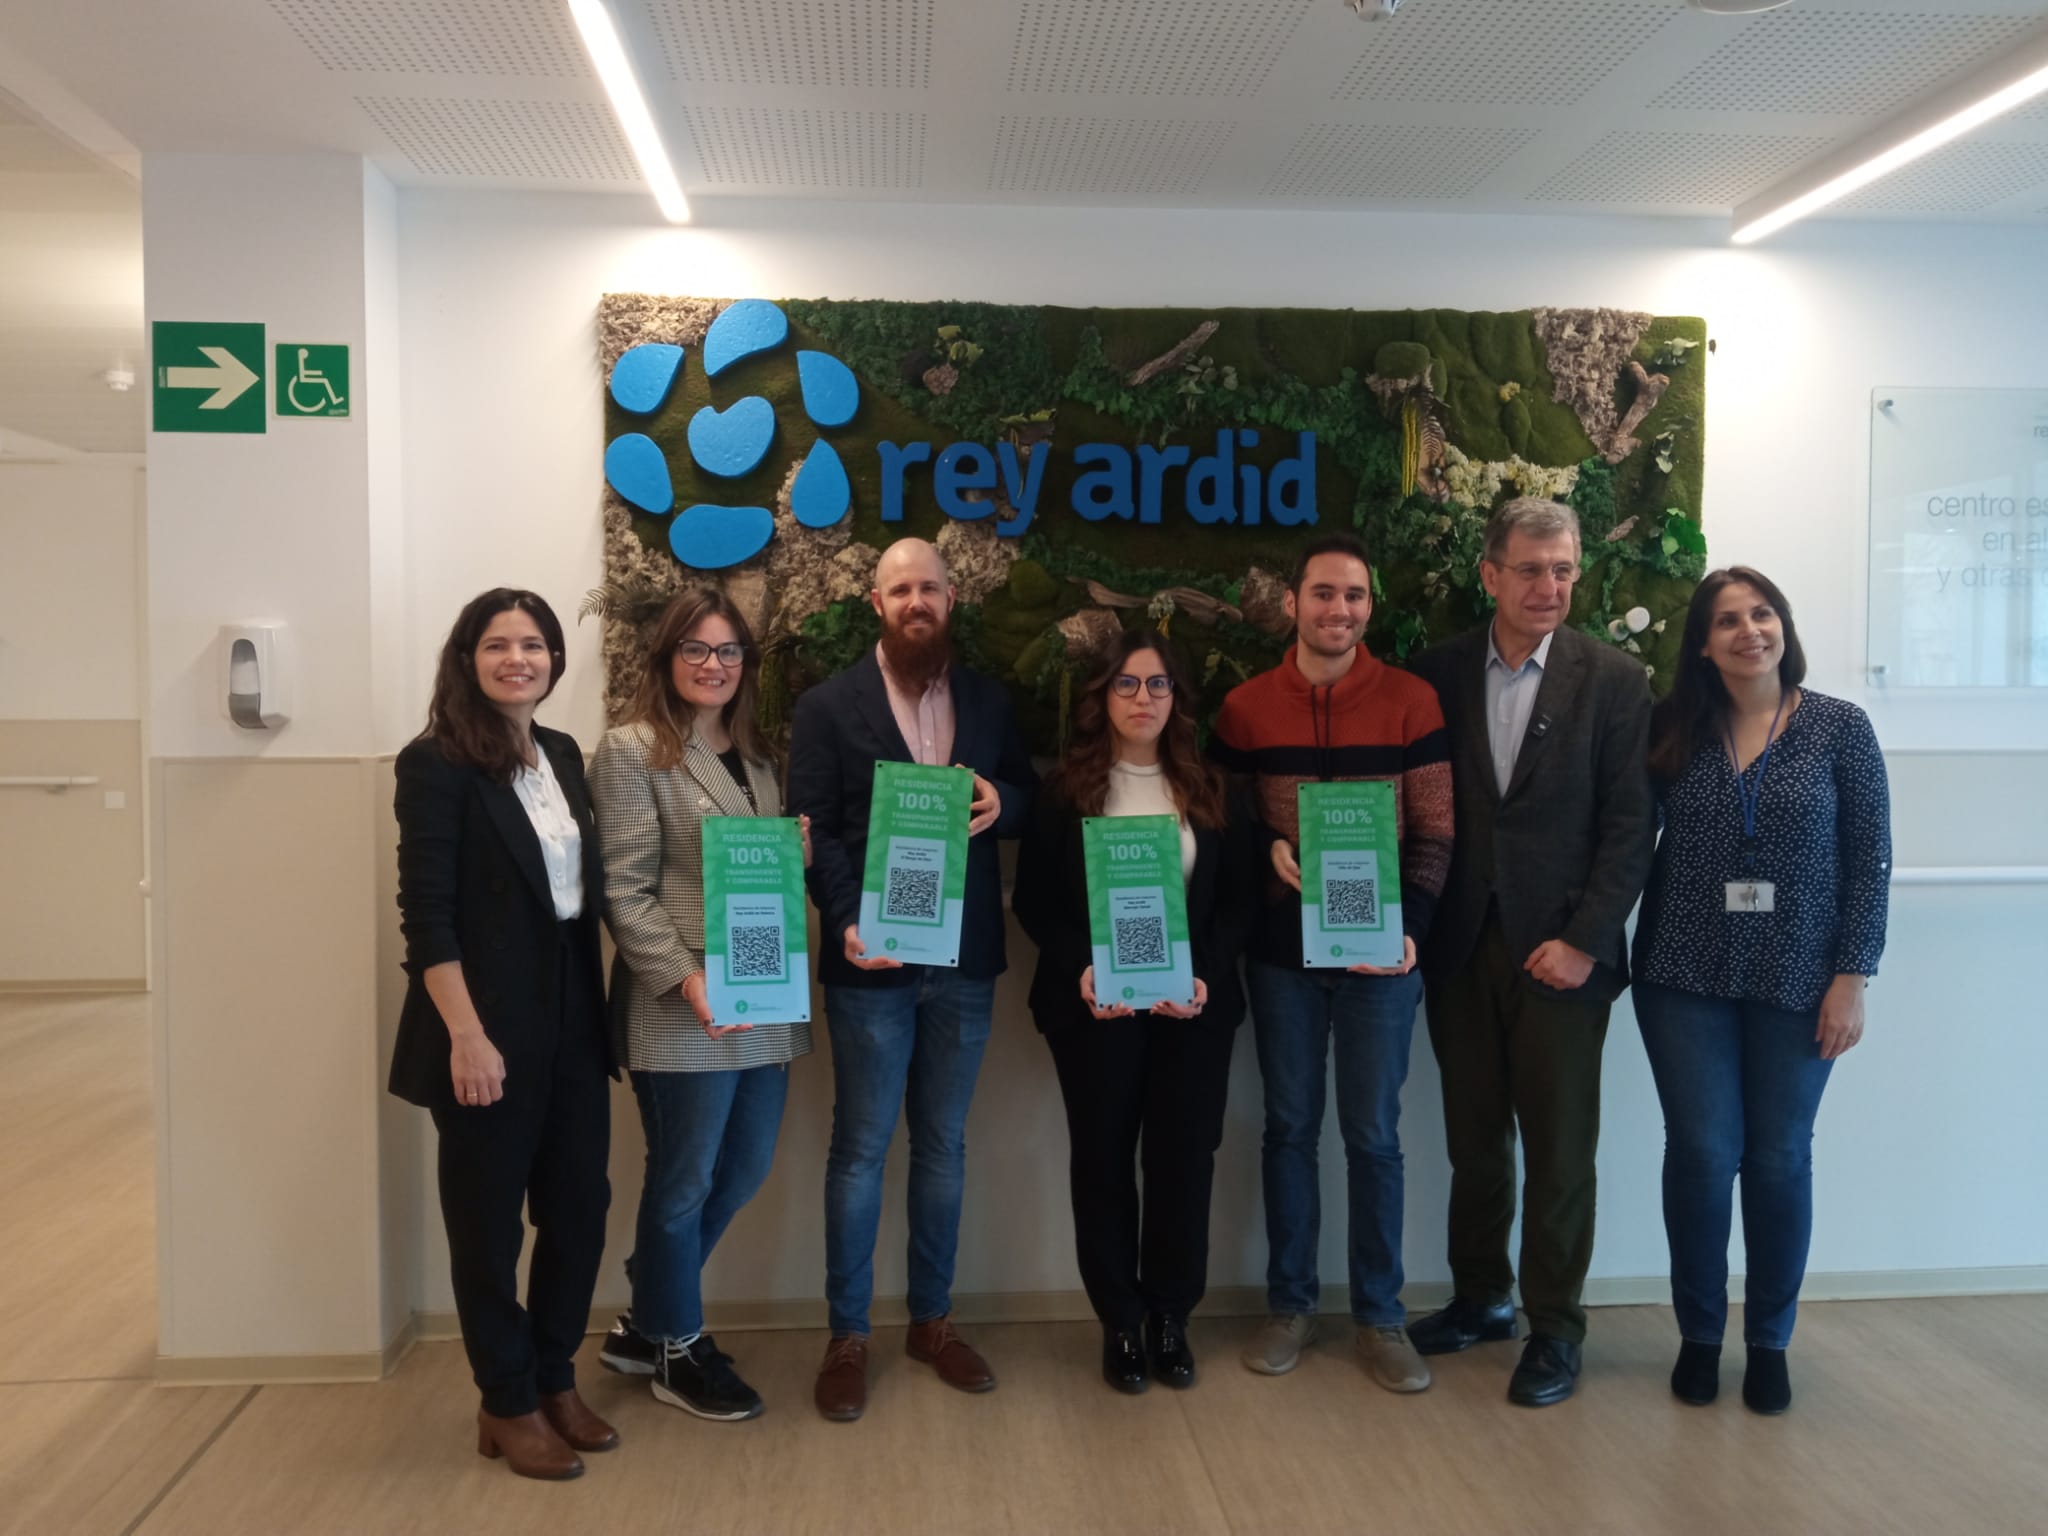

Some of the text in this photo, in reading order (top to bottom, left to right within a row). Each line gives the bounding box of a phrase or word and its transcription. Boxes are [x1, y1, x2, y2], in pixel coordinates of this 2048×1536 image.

[876, 428, 1319, 537] rey ardid
[1927, 492, 2016, 518] centro
[1983, 531, 2016, 552] en
[1937, 567, 1952, 593] y
[1961, 562, 2032, 587] otras
[896, 792, 947, 812] 100%
[1322, 808, 1373, 824] 100%
[722, 834, 782, 843] RESIDENCIA
[727, 847, 779, 865] 100%
[1107, 843, 1158, 861] 100%
